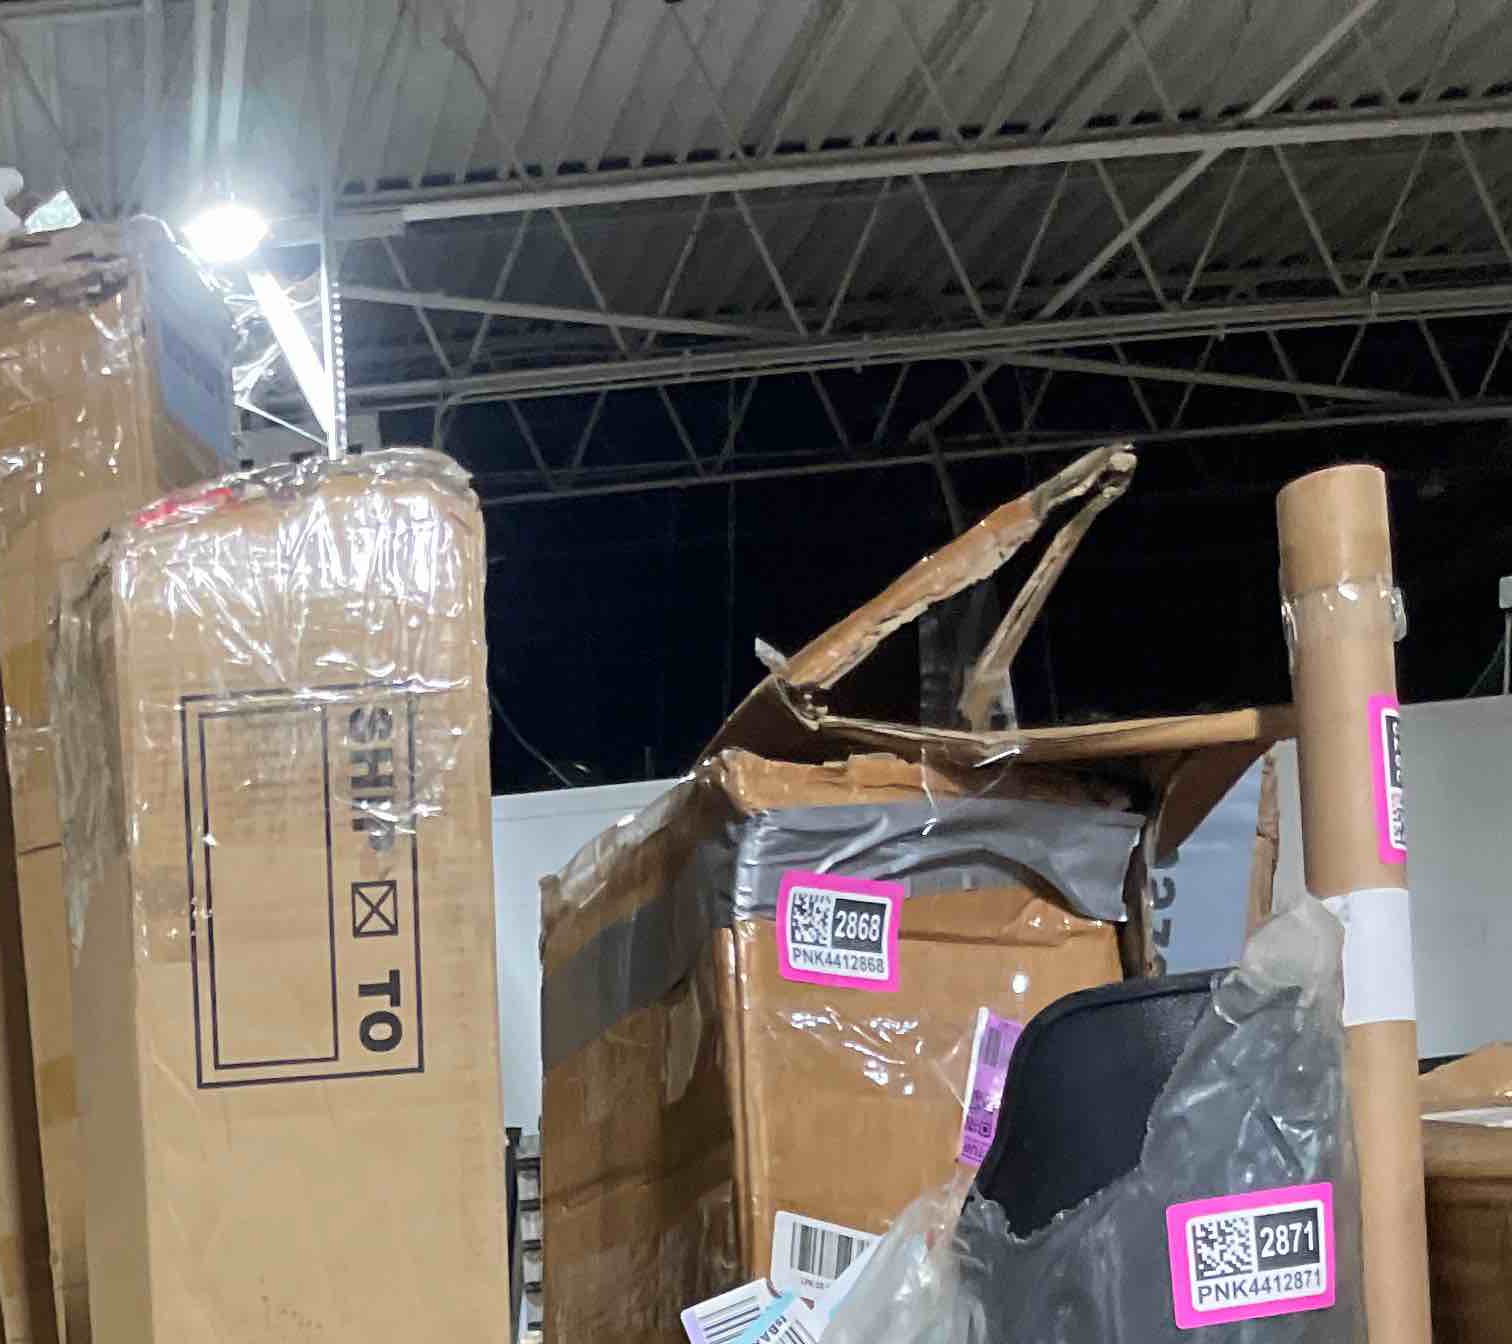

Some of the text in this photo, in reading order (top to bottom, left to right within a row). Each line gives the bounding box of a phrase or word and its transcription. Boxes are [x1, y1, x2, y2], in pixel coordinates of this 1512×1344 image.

[349, 706, 404, 1053] SHIP TO
[834, 910, 881, 942] 2868
[792, 947, 885, 974] PNK4412868
[1258, 1220, 1316, 1258] 2871
[1197, 1267, 1322, 1305] PNK4412871
